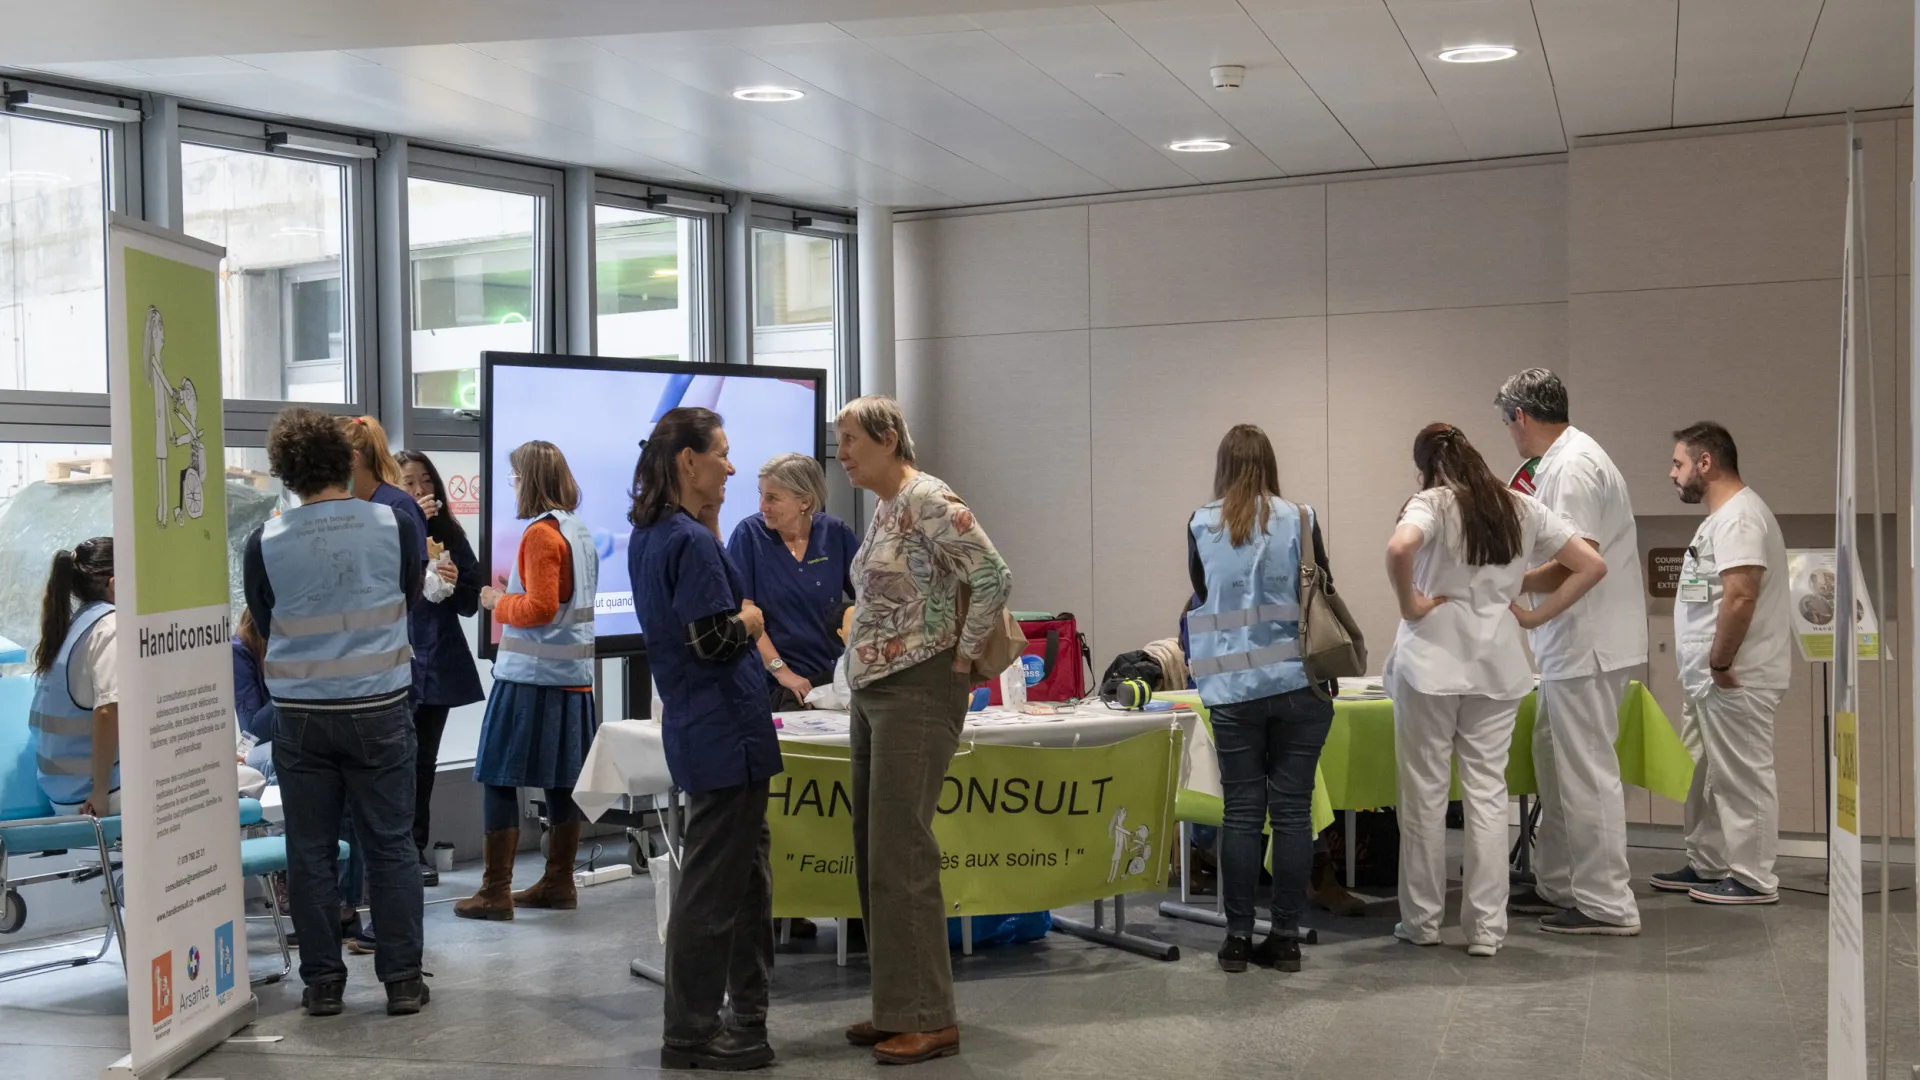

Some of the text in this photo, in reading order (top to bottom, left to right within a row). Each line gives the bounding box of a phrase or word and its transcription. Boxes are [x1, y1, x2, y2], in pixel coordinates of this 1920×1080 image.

[594, 596, 632, 610] ut quand
[139, 616, 230, 658] Handiconsult
[768, 776, 1113, 817] HANONSULT
[800, 854, 855, 874] Facili
[941, 852, 959, 870] ès
[966, 852, 999, 867] aux
[1006, 849, 1057, 867] soins
[180, 978, 210, 1012] Arsanté
